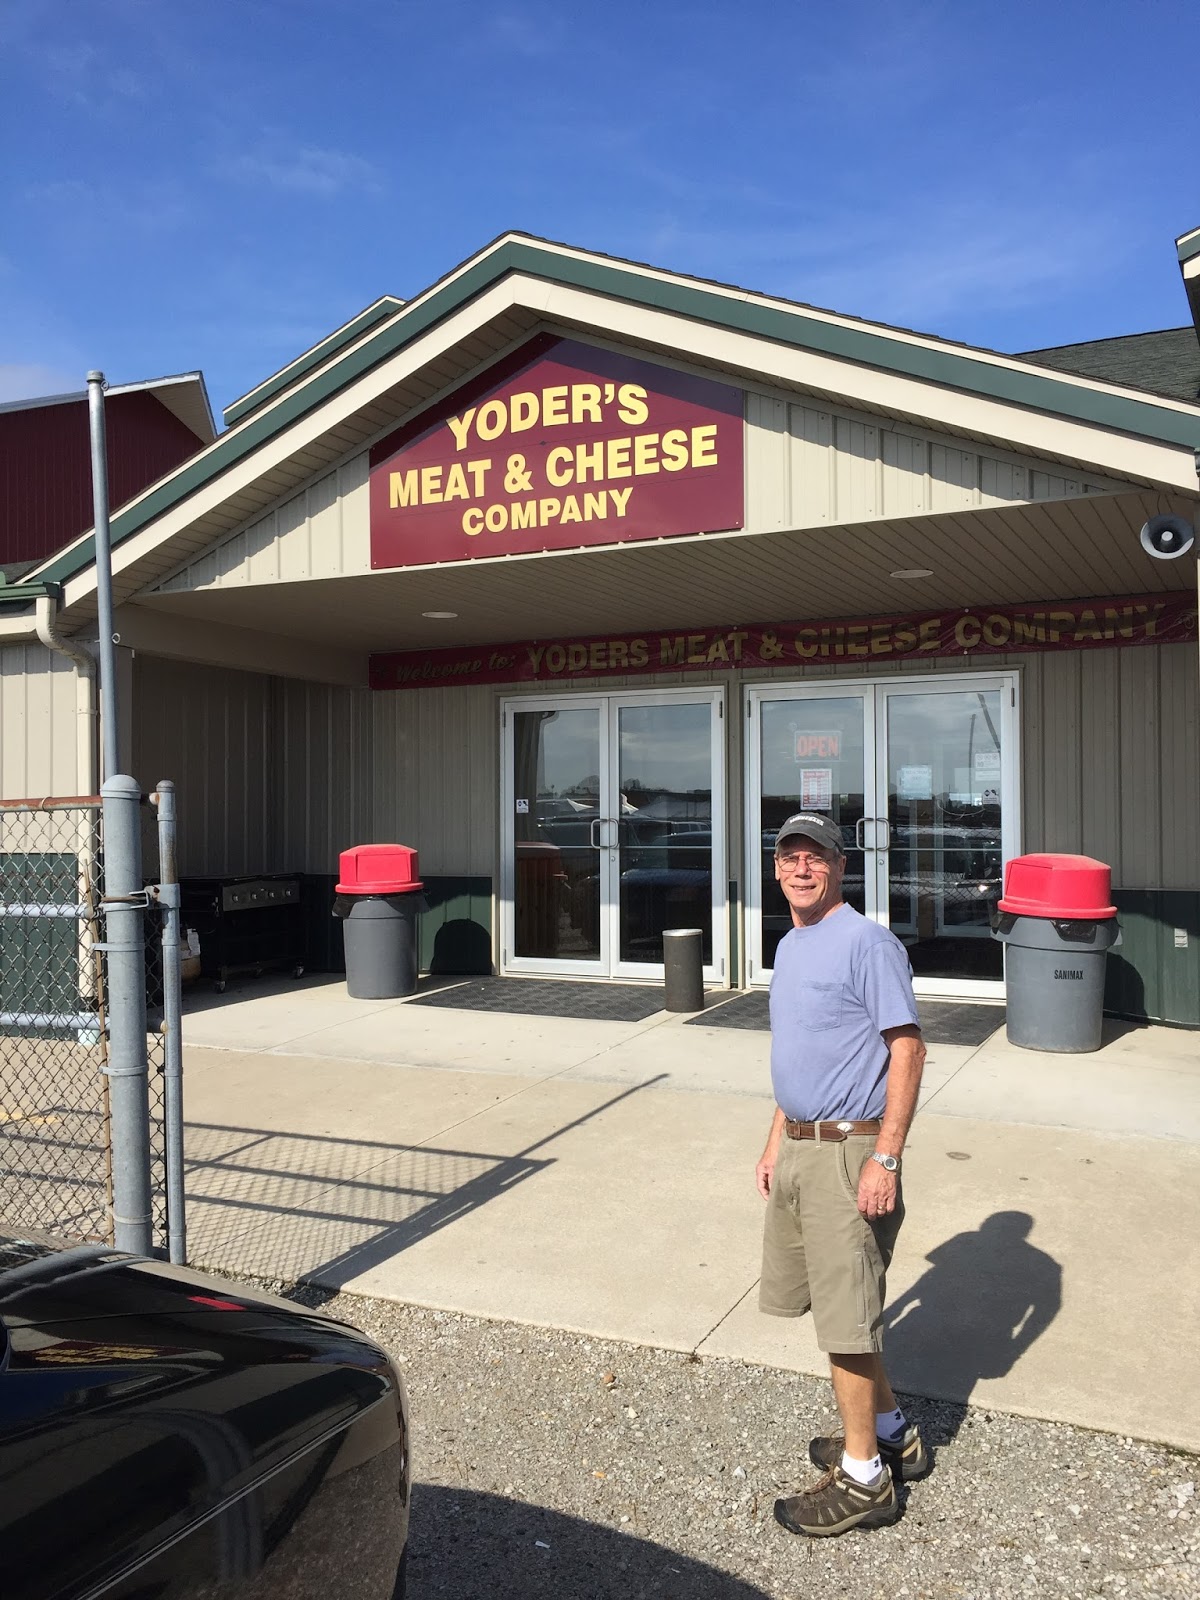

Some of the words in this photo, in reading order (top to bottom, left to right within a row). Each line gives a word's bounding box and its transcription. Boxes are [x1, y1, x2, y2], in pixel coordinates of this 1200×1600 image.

[446, 383, 649, 452] YODER'S
[389, 458, 492, 509] MEAT
[503, 453, 534, 494] &
[545, 424, 718, 487] CHEESE
[461, 486, 634, 536] COMPANY
[396, 658, 482, 684] Welcome
[527, 638, 650, 675] YODERS
[660, 631, 749, 665] MEAT
[759, 630, 785, 659] &
[794, 618, 941, 658] CHEESE
[954, 603, 1166, 648] COMPANY
[796, 735, 839, 757] OPEN
[1053, 969, 1084, 980] SANIMAX
